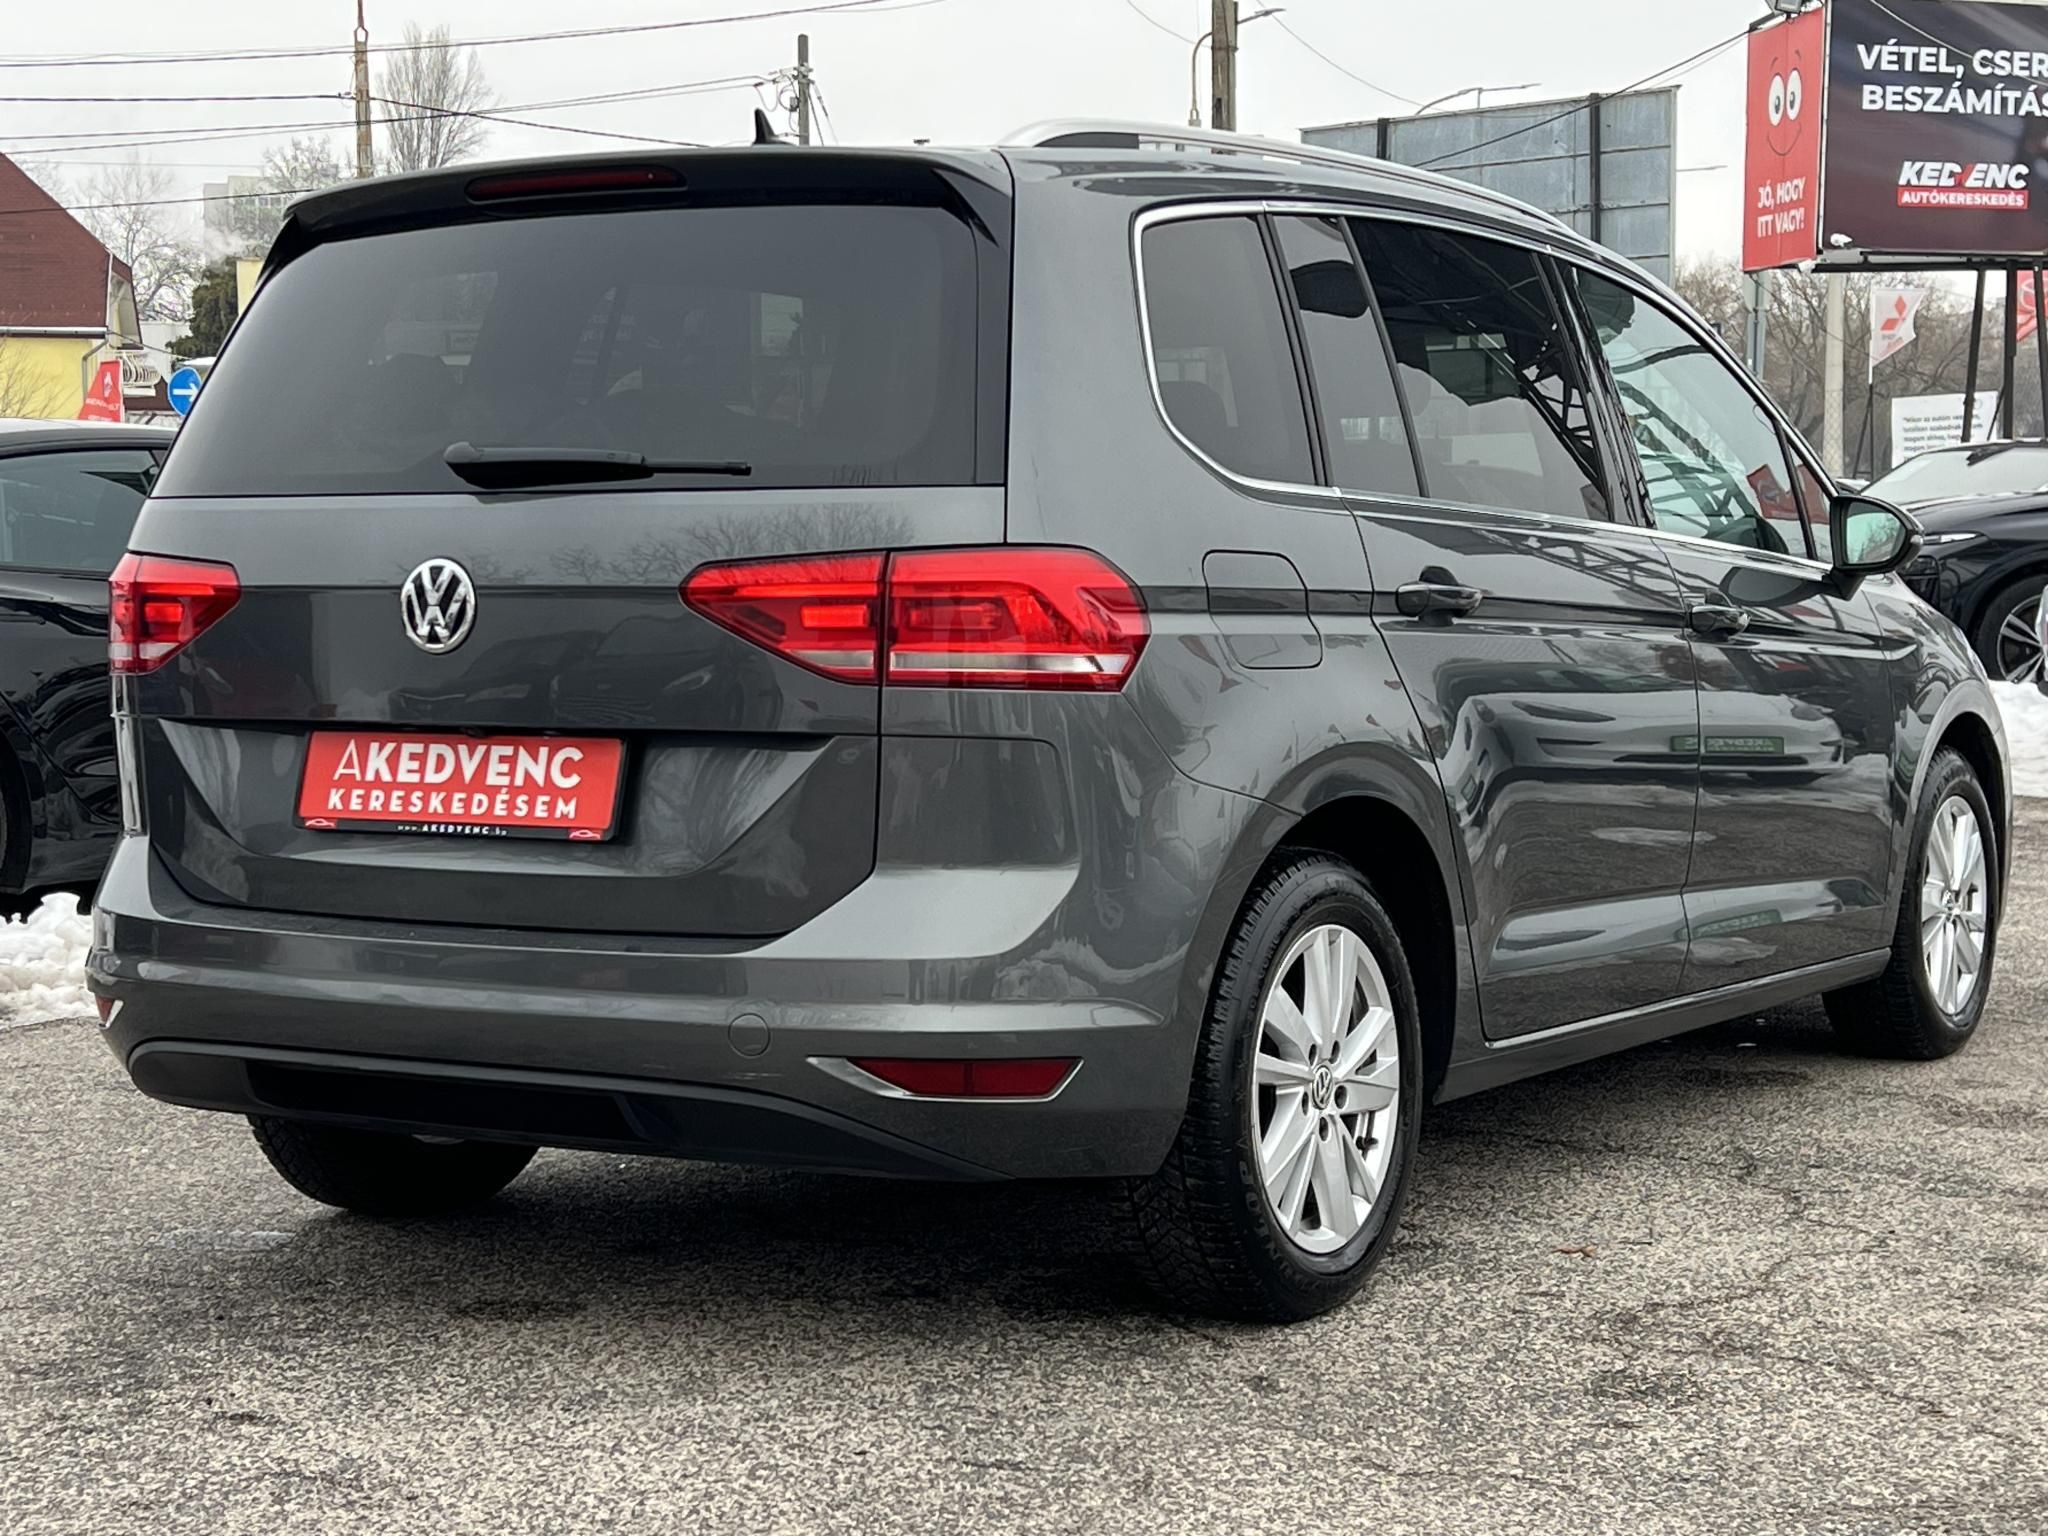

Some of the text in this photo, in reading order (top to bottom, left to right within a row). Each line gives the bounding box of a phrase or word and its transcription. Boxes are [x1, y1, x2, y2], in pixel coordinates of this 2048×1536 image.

[1856, 39, 1965, 79] VÉTEL,
[1757, 176, 1806, 210] JÓ, HOGY
[1901, 189, 2025, 207] AUTÓKERESKEDÉS
[1757, 207, 1805, 238] ITT VAGY!
[333, 738, 585, 788] AKEDVENC
[327, 787, 578, 819] KERESKEDÉSEM
